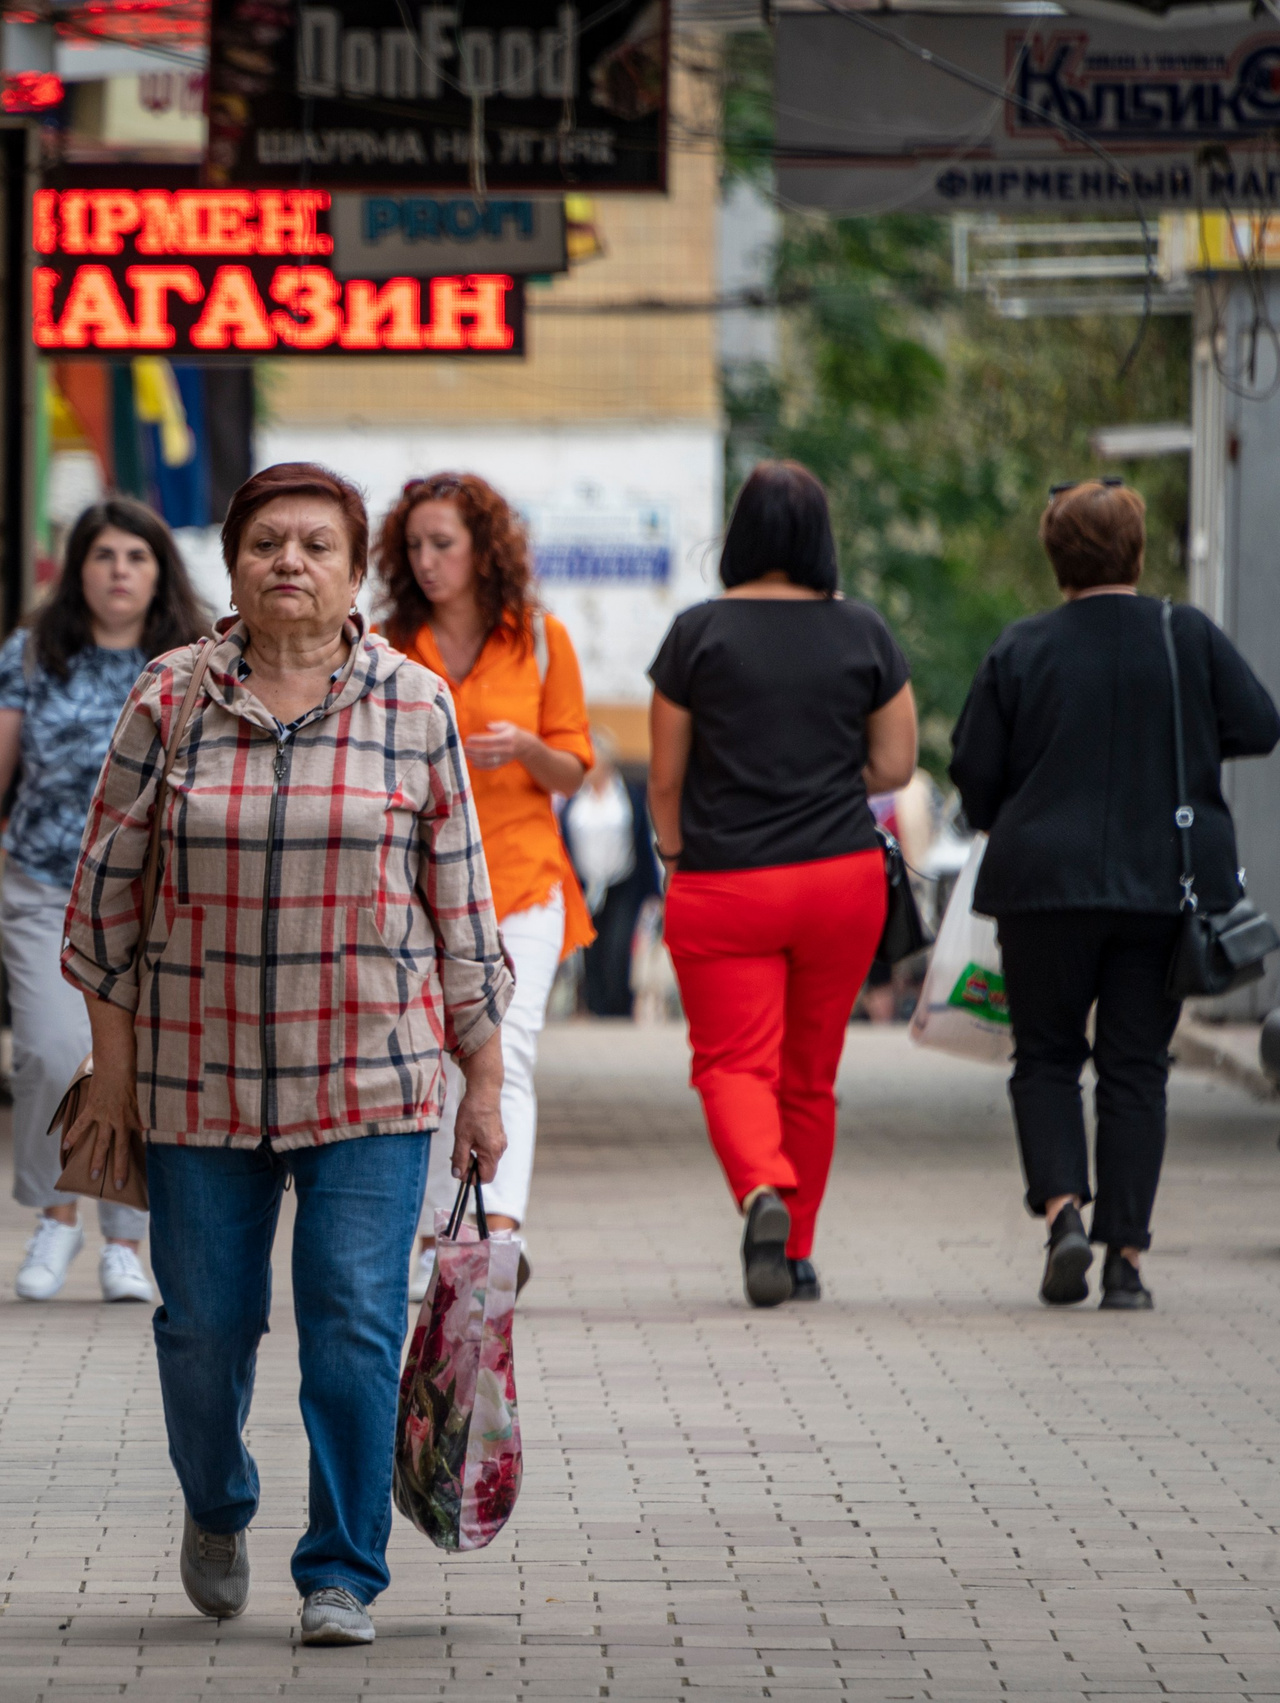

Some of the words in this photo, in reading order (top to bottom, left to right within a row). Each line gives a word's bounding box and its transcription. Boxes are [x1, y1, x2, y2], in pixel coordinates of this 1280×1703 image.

[297, 5, 578, 98] DonFood
[256, 128, 426, 165] ШАУРМА
[934, 167, 1192, 201] ФИРМЕННЫЙ
